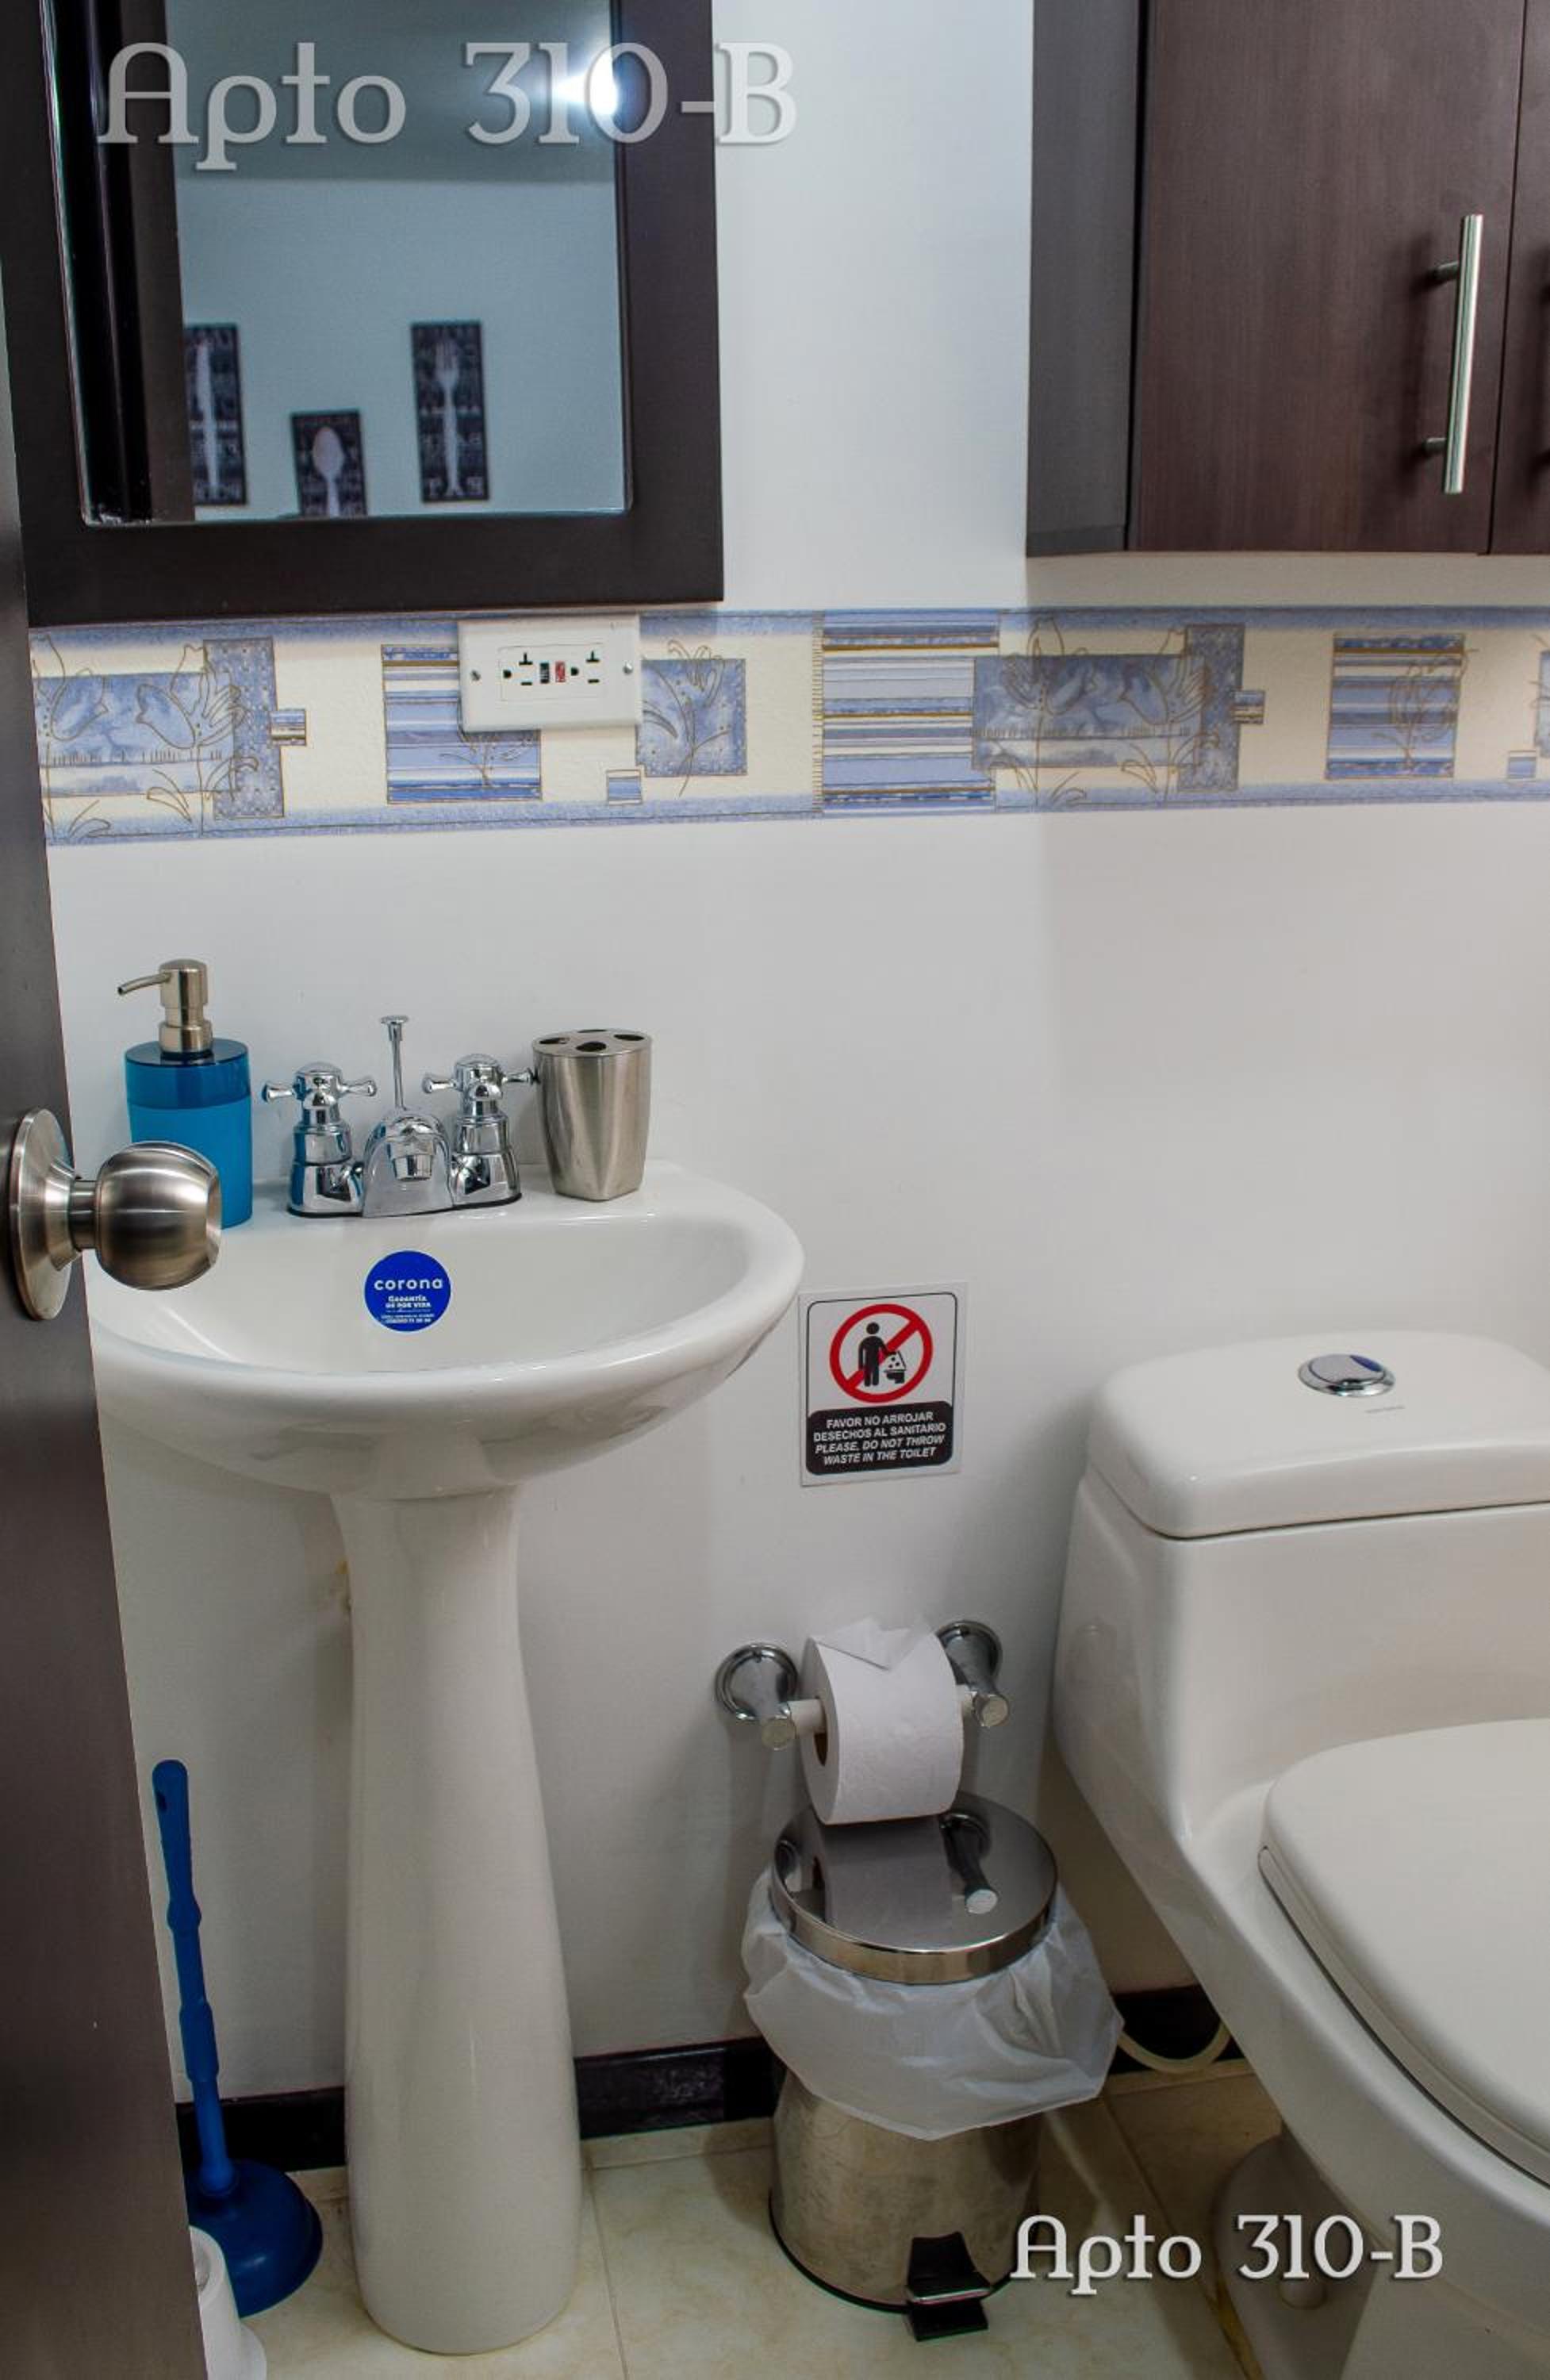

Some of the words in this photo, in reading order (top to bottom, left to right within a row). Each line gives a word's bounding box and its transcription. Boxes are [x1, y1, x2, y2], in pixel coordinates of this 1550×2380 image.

[374, 1278, 443, 1291] corona
[827, 1418, 862, 1429] FAVOR
[865, 1416, 881, 1426] NO
[882, 1411, 934, 1424] ARROJAR
[813, 1428, 872, 1442] DESECHOS
[874, 1428, 888, 1437] AL
[890, 1422, 946, 1436] SANITARIO
[862, 1440, 878, 1450] DO
[881, 1438, 903, 1449] NOT
[905, 1434, 946, 1446] THROW
[823, 1453, 861, 1465] WASTE
[862, 1452, 875, 1462] IN
[877, 1450, 897, 1461] THE
[900, 1446, 937, 1459] TOILET
